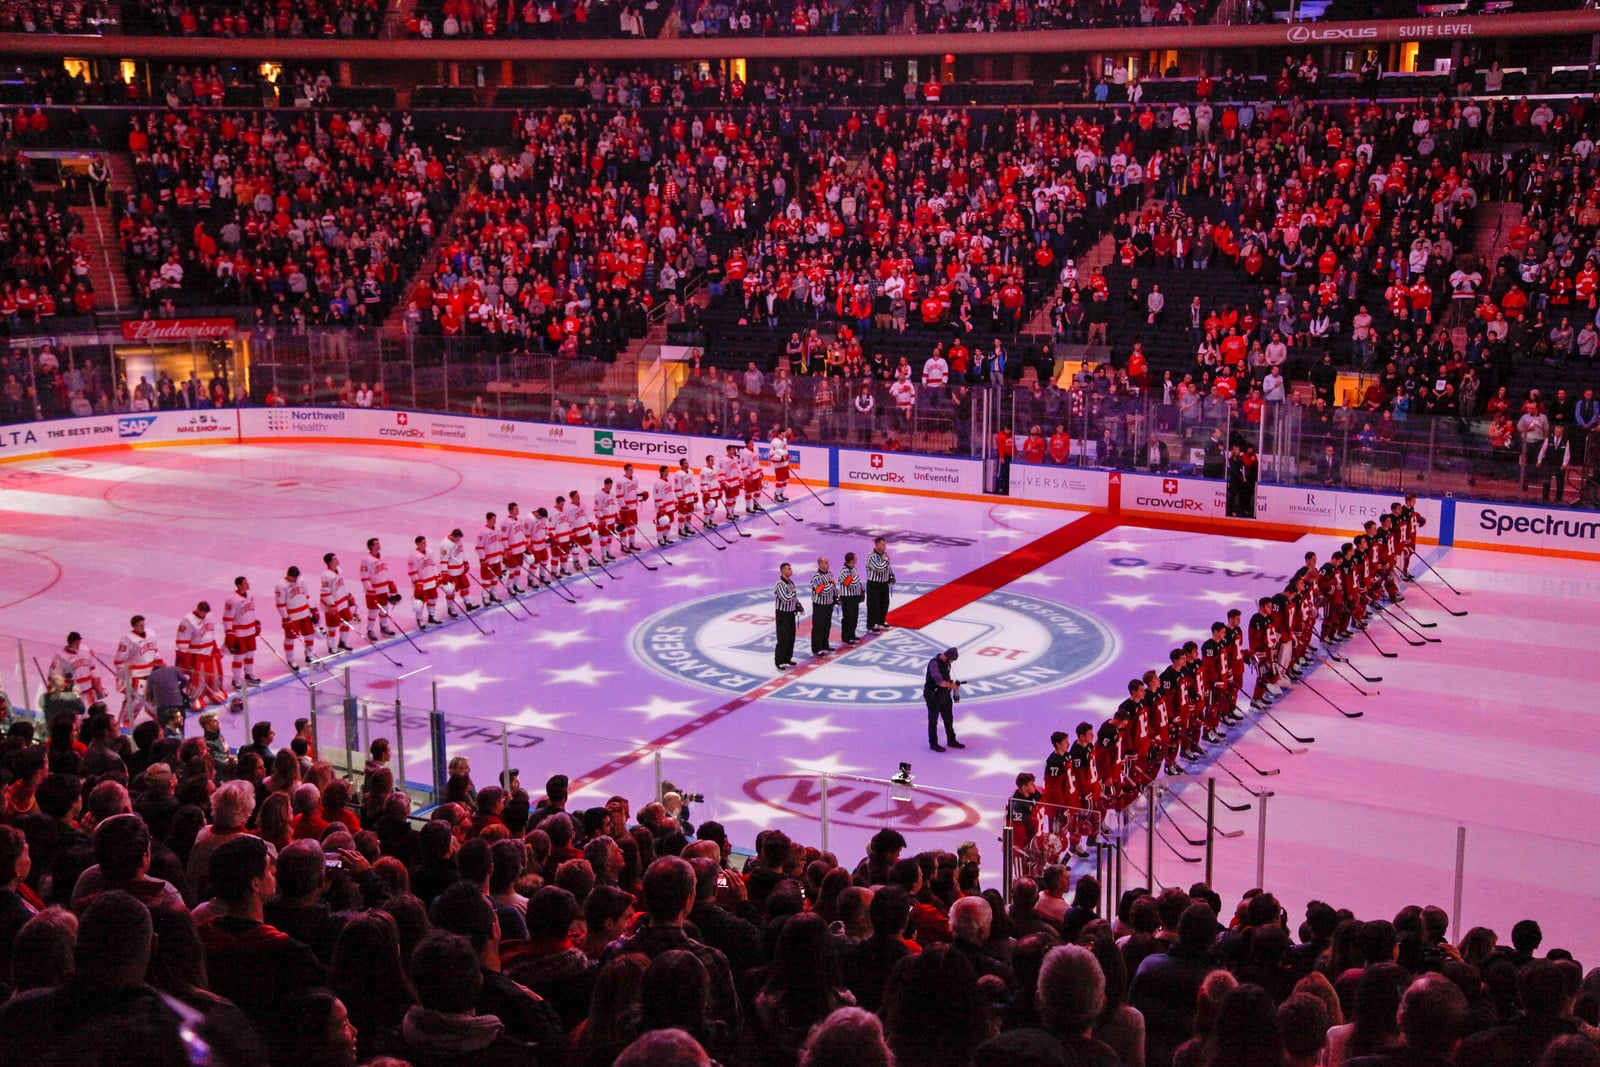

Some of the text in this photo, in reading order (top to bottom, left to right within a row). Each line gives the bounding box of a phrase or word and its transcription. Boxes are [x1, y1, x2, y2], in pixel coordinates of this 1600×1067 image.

[1312, 27, 1377, 39] LEXUS
[1399, 23, 1474, 37] SUITE LEVEL
[130, 320, 230, 339] Budweiser
[292, 410, 345, 421] Northwell
[48, 425, 113, 438] THE BEST RUN
[119, 420, 150, 435] SAP
[292, 422, 326, 432] Health
[379, 427, 425, 439] crowdRx
[600, 436, 687, 455] enterprise
[849, 470, 905, 483] crowdRx
[914, 472, 959, 483] UnEventful
[1027, 477, 1068, 489] VERSA
[1136, 496, 1203, 511] crowdRx
[1306, 493, 1316, 505] R
[1339, 504, 1387, 517] VERSA
[1480, 509, 1600, 539] Spectrum
[1156, 561, 1290, 583] HASE
[728, 613, 775, 625] 26
[1004, 599, 1085, 635] MADISON
[651, 624, 758, 688] RANGERS
[976, 645, 1029, 661] 19
[959, 666, 1061, 695] NEW
[787, 779, 945, 826] KIA
[1013, 812, 1023, 822] 32
